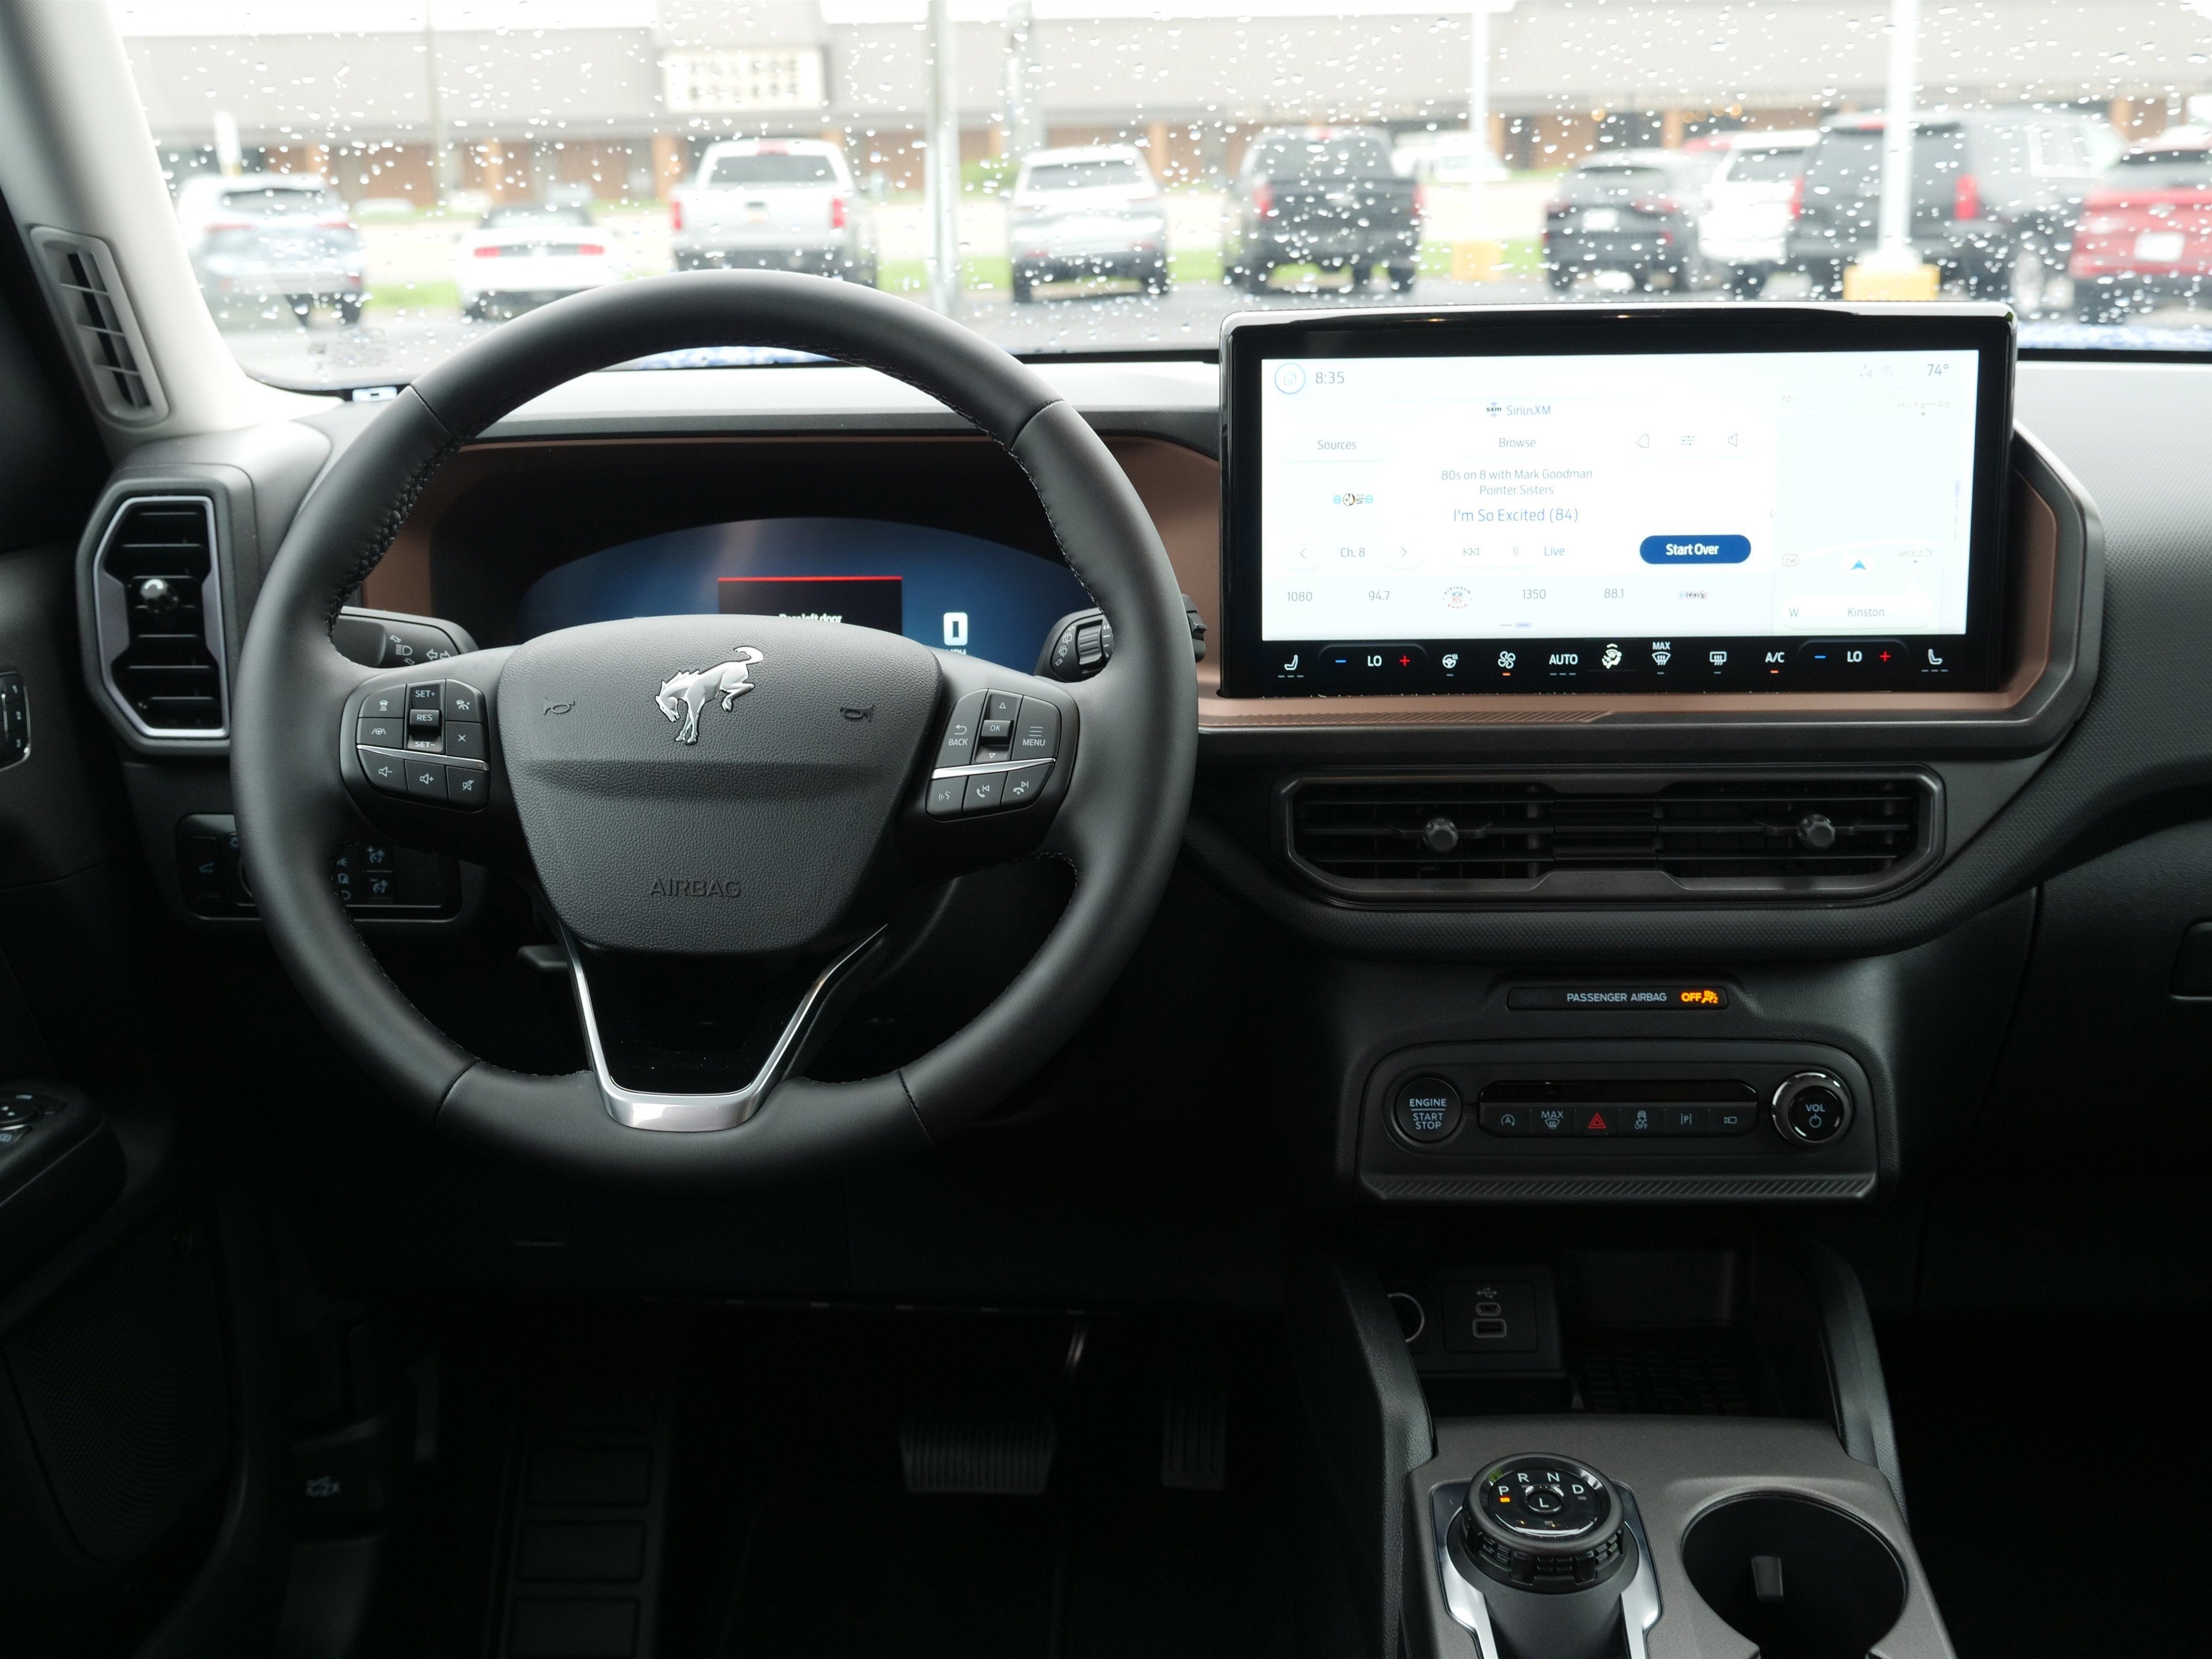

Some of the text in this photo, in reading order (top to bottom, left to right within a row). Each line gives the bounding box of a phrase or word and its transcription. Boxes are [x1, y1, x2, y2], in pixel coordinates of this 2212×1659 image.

[1926, 363, 1949, 376] 74°
[1315, 371, 1345, 385] 8:35
[1507, 405, 1550, 416] SiriusXM
[1317, 440, 1357, 450] Sources
[1499, 437, 1536, 448] Browse
[1441, 468, 1592, 481] 80s on 8 with Mark Goodman
[1480, 484, 1554, 496] Pointer Sisters
[1454, 508, 1578, 523] I'm So Excited (84)
[1340, 547, 1365, 558] Ch. 8
[1544, 545, 1565, 556] Live
[1665, 543, 1719, 556] Start Over
[1287, 591, 1313, 602] 1080
[1368, 590, 1390, 601] 94.7
[1522, 589, 1546, 599] 1350
[1603, 588, 1624, 599] 88.1
[819, 612, 842, 623] door
[1789, 607, 1885, 617] W Kinston
[943, 612, 968, 646] 0
[1652, 641, 1671, 650] MAX
[1367, 655, 1382, 667] LO
[1549, 654, 1578, 665] AUTO
[1765, 652, 1785, 663] A/C
[1847, 651, 1863, 662] LO
[1022, 738, 1046, 746] MENU
[649, 877, 741, 898] AIRBAG
[1567, 993, 1627, 1002] PASSENGER
[1630, 992, 1667, 1002] AIRBAG
[1681, 992, 1702, 1003] OFF
[1410, 1098, 1447, 1107] ENGINE
[1805, 1103, 1826, 1112] VOL
[1413, 1112, 1444, 1121] START
[1541, 1110, 1564, 1119] MAX
[1415, 1121, 1441, 1130] STOP
[1517, 1473, 1530, 1482] R
[1547, 1472, 1560, 1482] N
[1498, 1486, 1509, 1496] P
[1572, 1484, 1584, 1494] D
[1539, 1498, 1549, 1508] L
